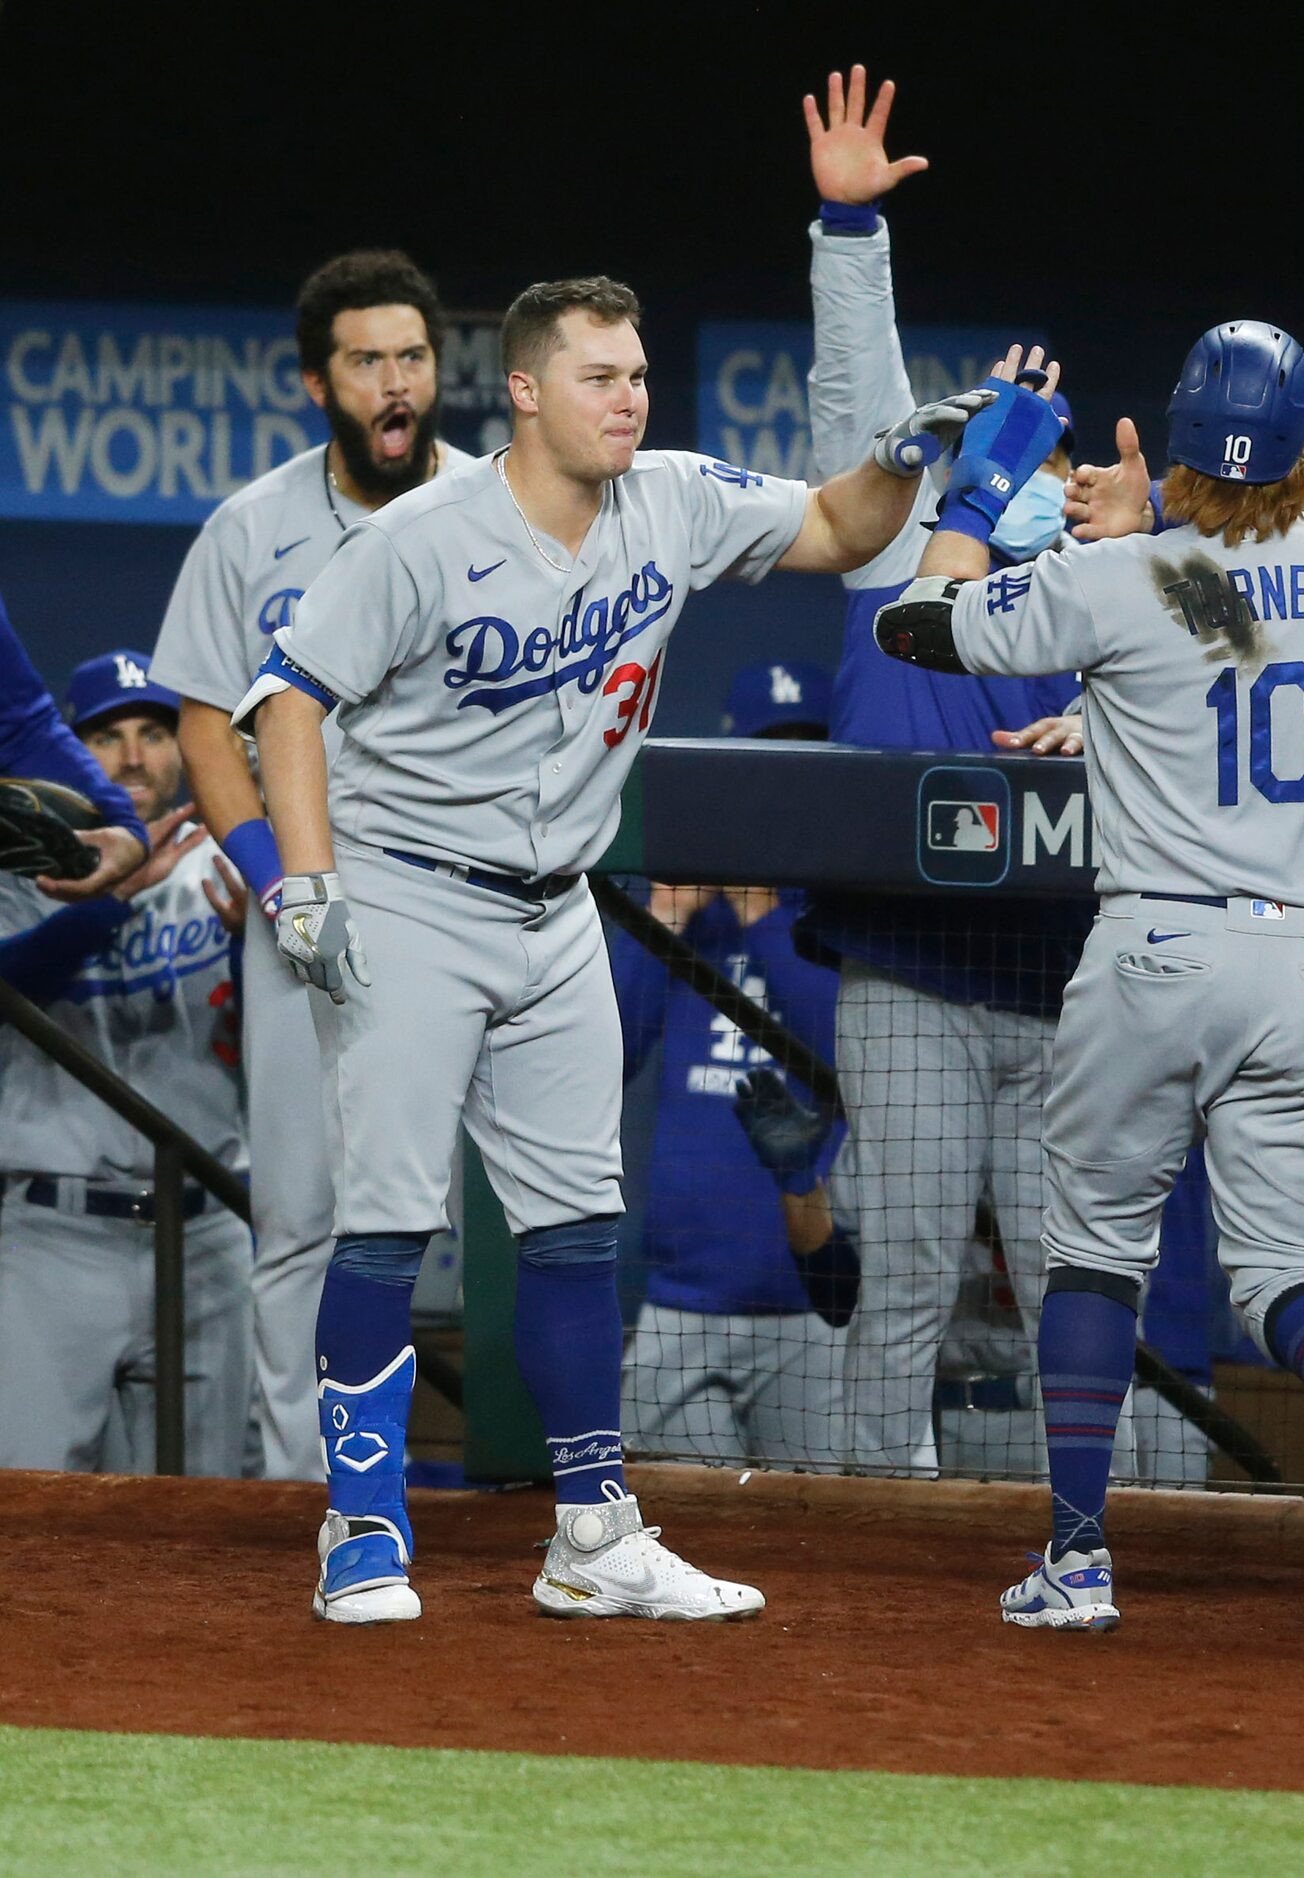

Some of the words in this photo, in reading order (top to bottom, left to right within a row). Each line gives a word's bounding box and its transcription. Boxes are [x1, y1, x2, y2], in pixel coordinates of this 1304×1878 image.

[8, 331, 311, 412] CAMPING
[11, 404, 313, 498] WORLD
[990, 472, 1011, 493] 10
[1224, 434, 1252, 464] 10
[602, 648, 663, 749] 31
